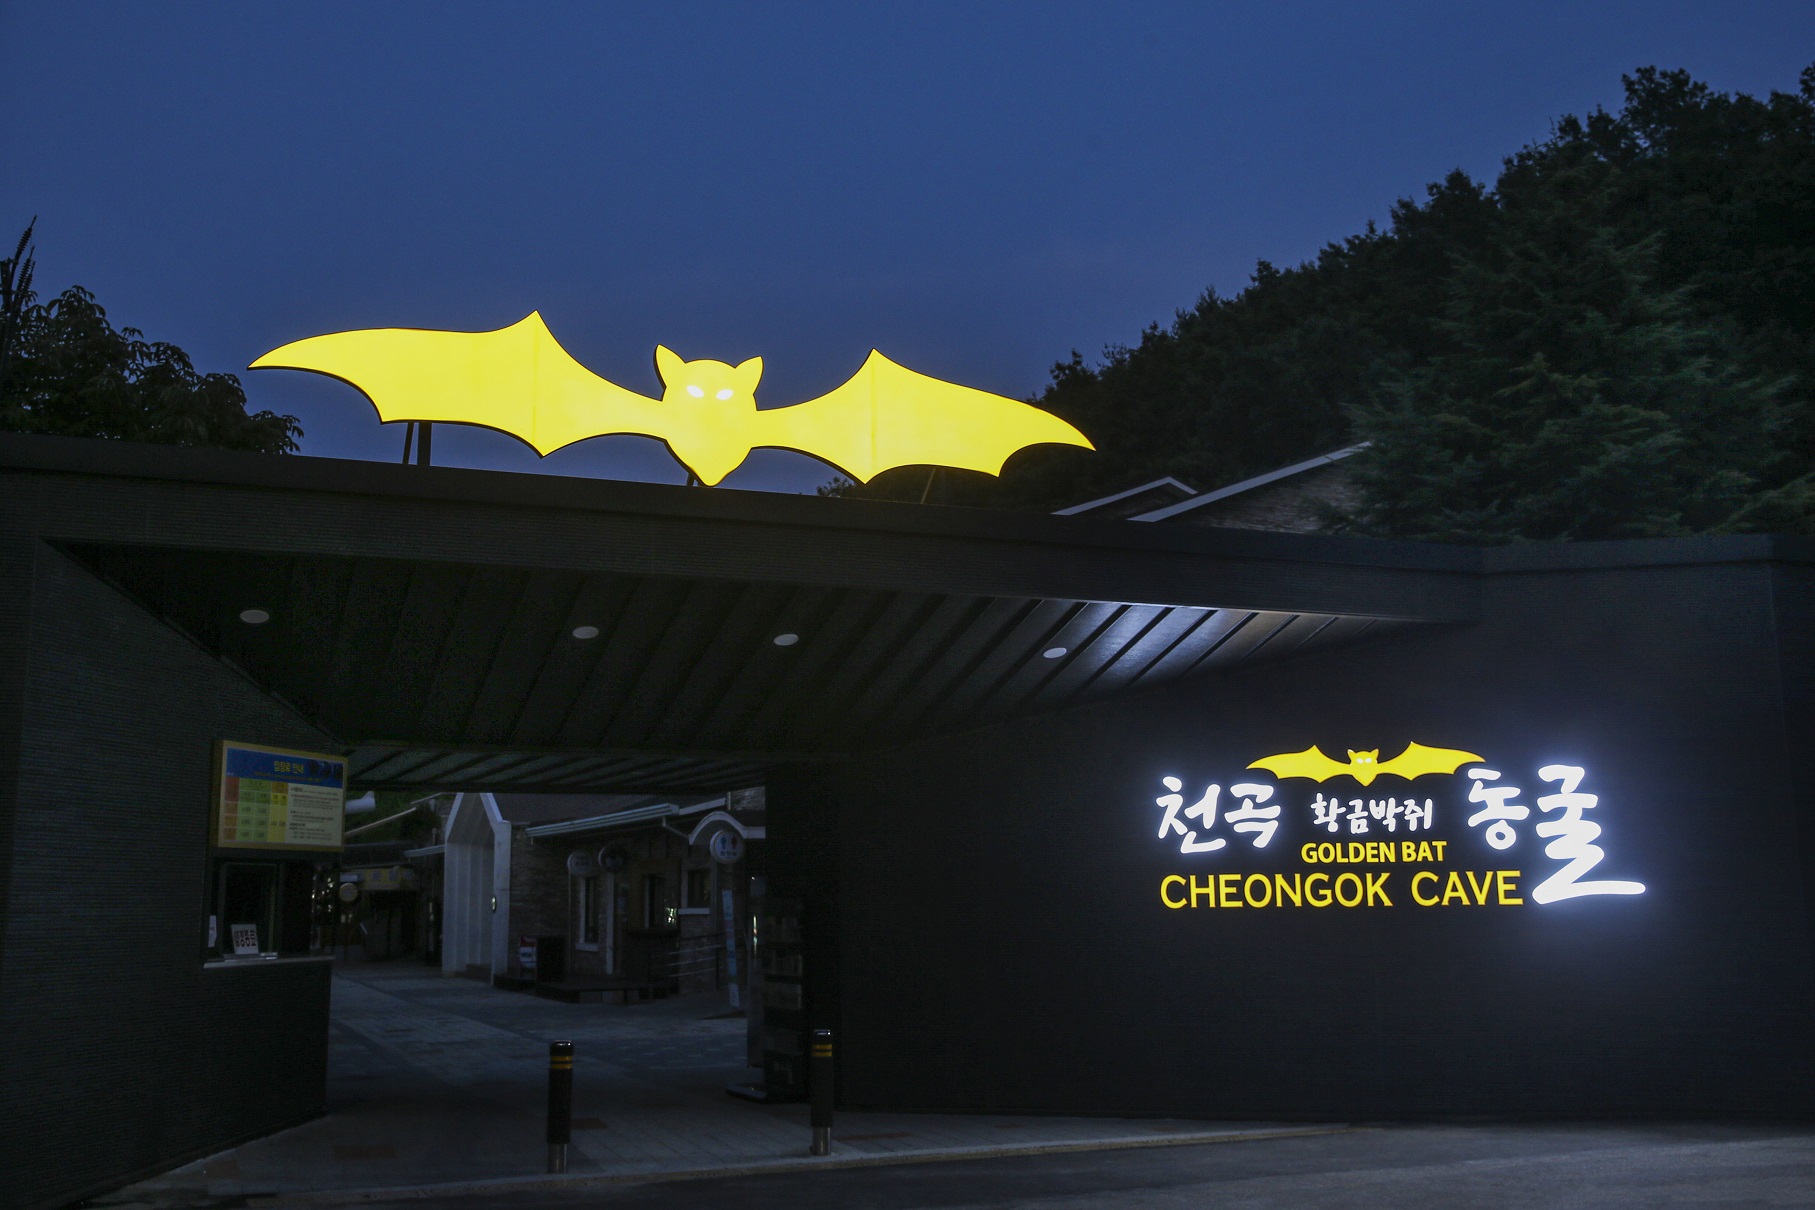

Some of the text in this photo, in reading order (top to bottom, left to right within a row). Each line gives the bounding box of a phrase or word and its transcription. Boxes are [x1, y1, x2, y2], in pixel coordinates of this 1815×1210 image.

[1156, 765, 1645, 904] 천곡 황금박쥐 동굴
[1301, 841, 1447, 863] GOLDEN BAT
[1161, 871, 1523, 908] CHEONGOK CAVE
